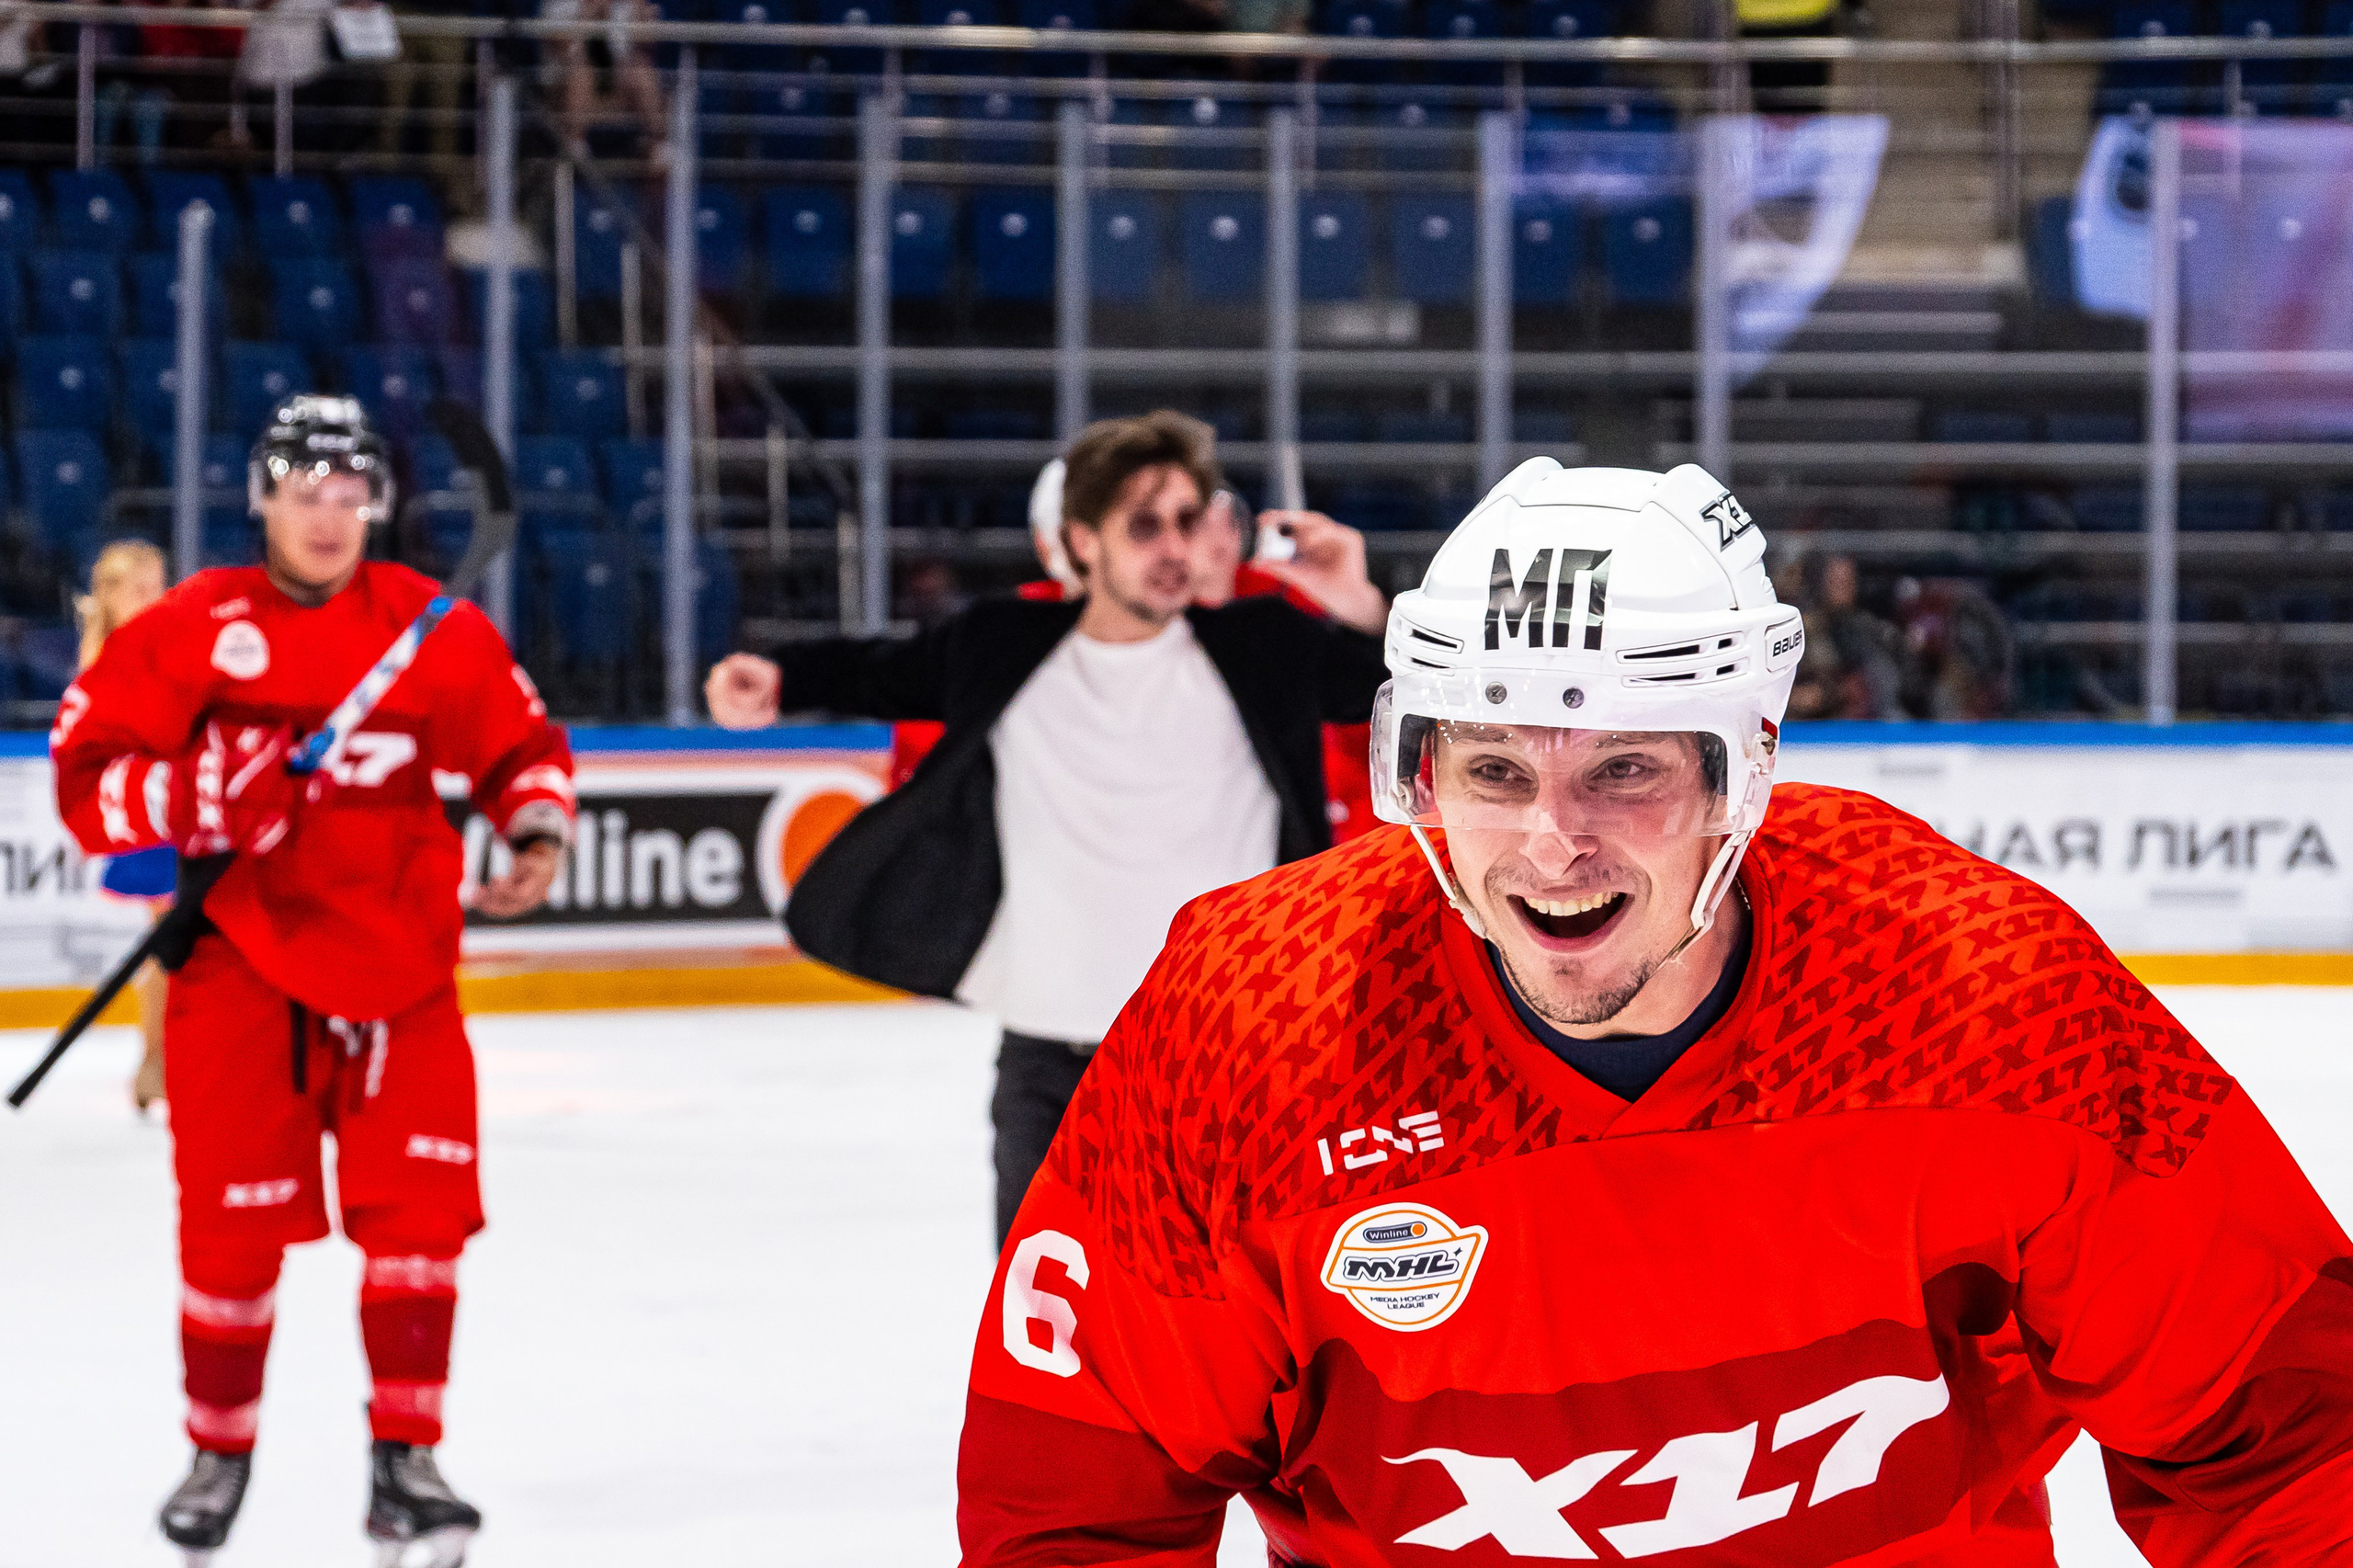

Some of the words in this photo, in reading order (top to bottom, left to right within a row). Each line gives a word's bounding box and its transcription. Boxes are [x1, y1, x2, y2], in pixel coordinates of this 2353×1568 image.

[1772, 629, 1802, 657] BAUE
[2126, 814, 2337, 873] ЛИГА
[1369, 1229, 1409, 1240] Winline
[1346, 1252, 1457, 1279] MHL
[1003, 1229, 1091, 1378] 6
[1370, 1295, 1398, 1303] MEDIA
[1400, 1292, 1440, 1302] HOCKEY
[1387, 1301, 1425, 1310] LEAGUE
[1381, 1371, 1950, 1561] X17
